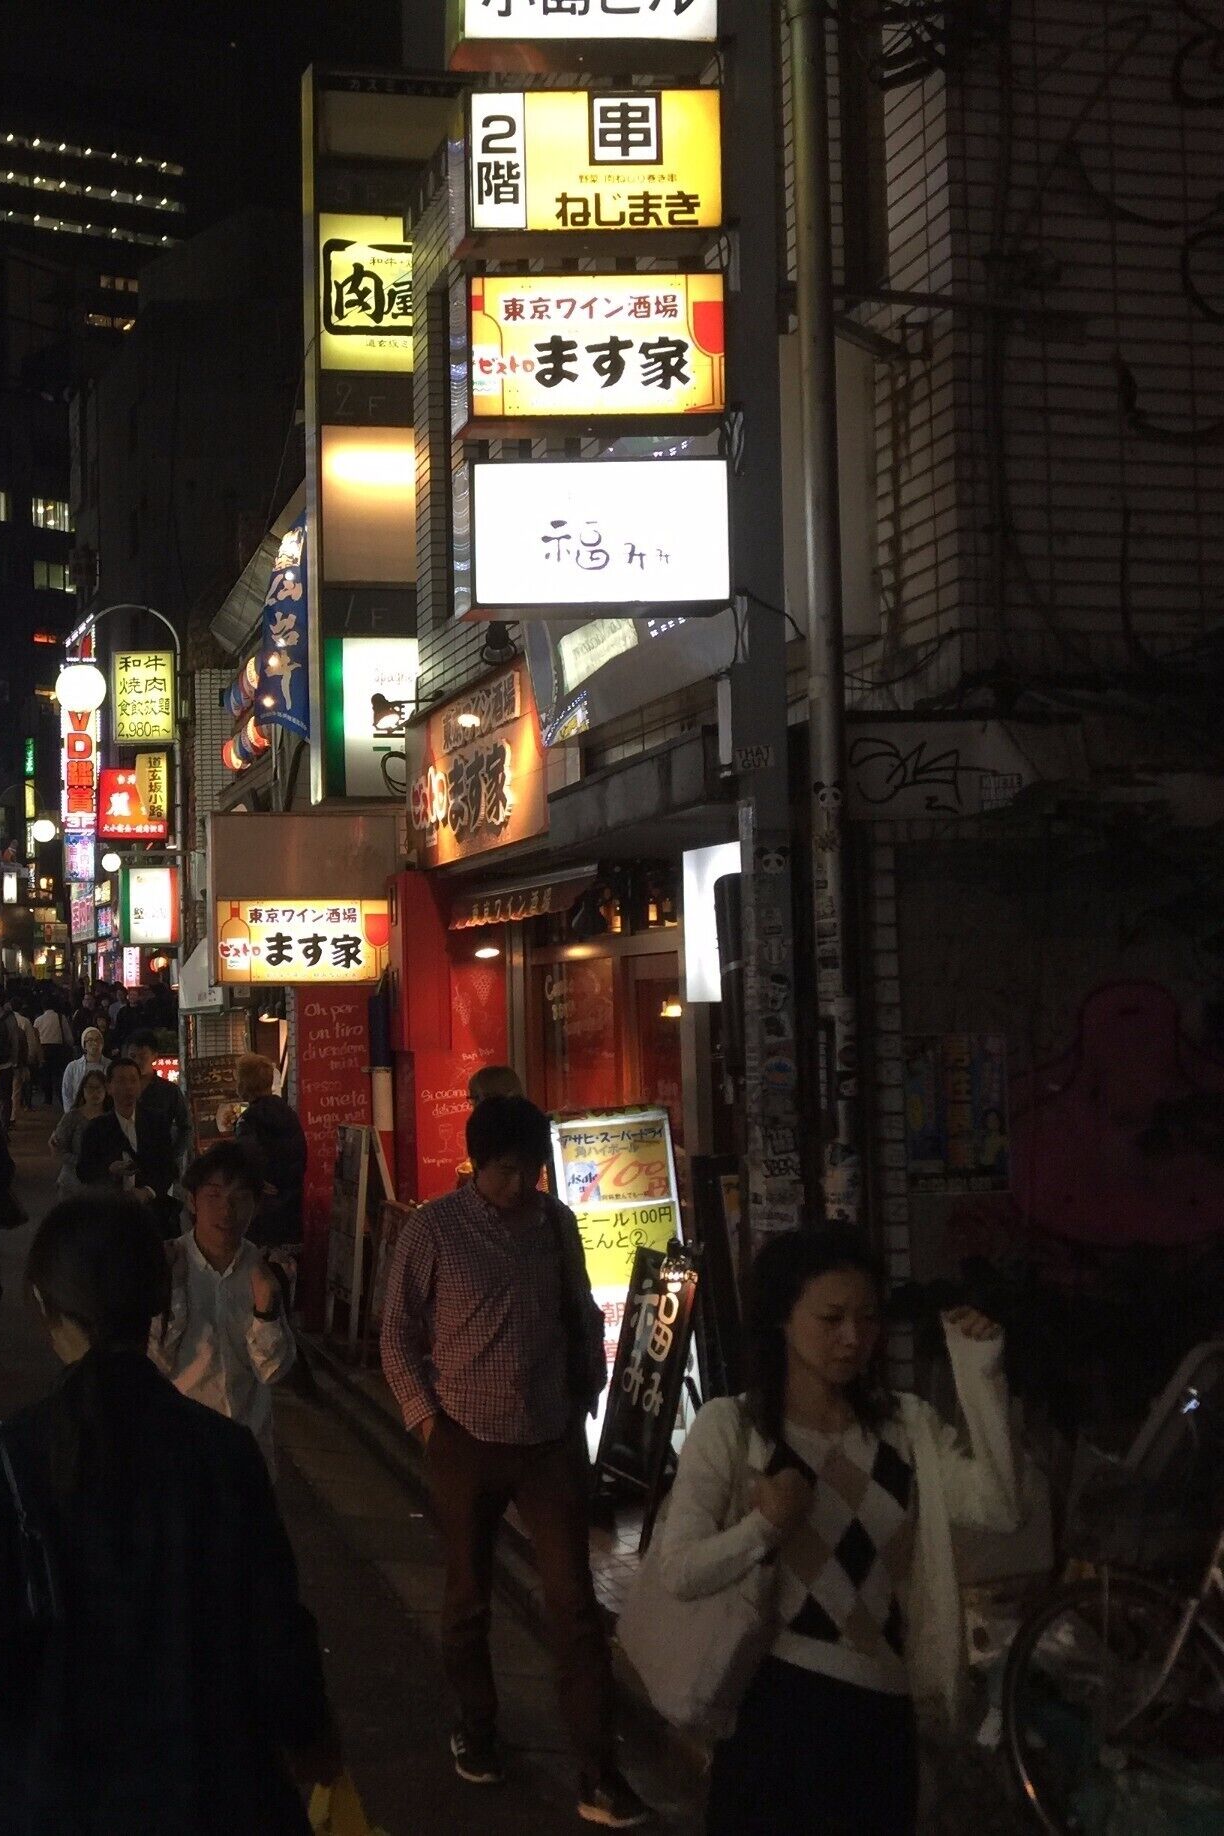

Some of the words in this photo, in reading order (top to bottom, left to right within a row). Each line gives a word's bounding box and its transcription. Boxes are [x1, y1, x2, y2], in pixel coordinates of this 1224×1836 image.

[599, 102, 651, 156] 串
[477, 114, 520, 205] 2階
[555, 191, 701, 226] ねじまき
[503, 294, 679, 321] 東京ワイン酒場
[479, 357, 536, 375] ビストロ
[534, 335, 691, 390] ます家
[119, 655, 166, 672] 和牛
[119, 677, 166, 694] 焼肉
[148, 757, 163, 817] 道玄坂小路
[249, 908, 358, 924] 東京ワイン酒場
[219, 943, 261, 958] ビストロ
[265, 932, 363, 968] ます家
